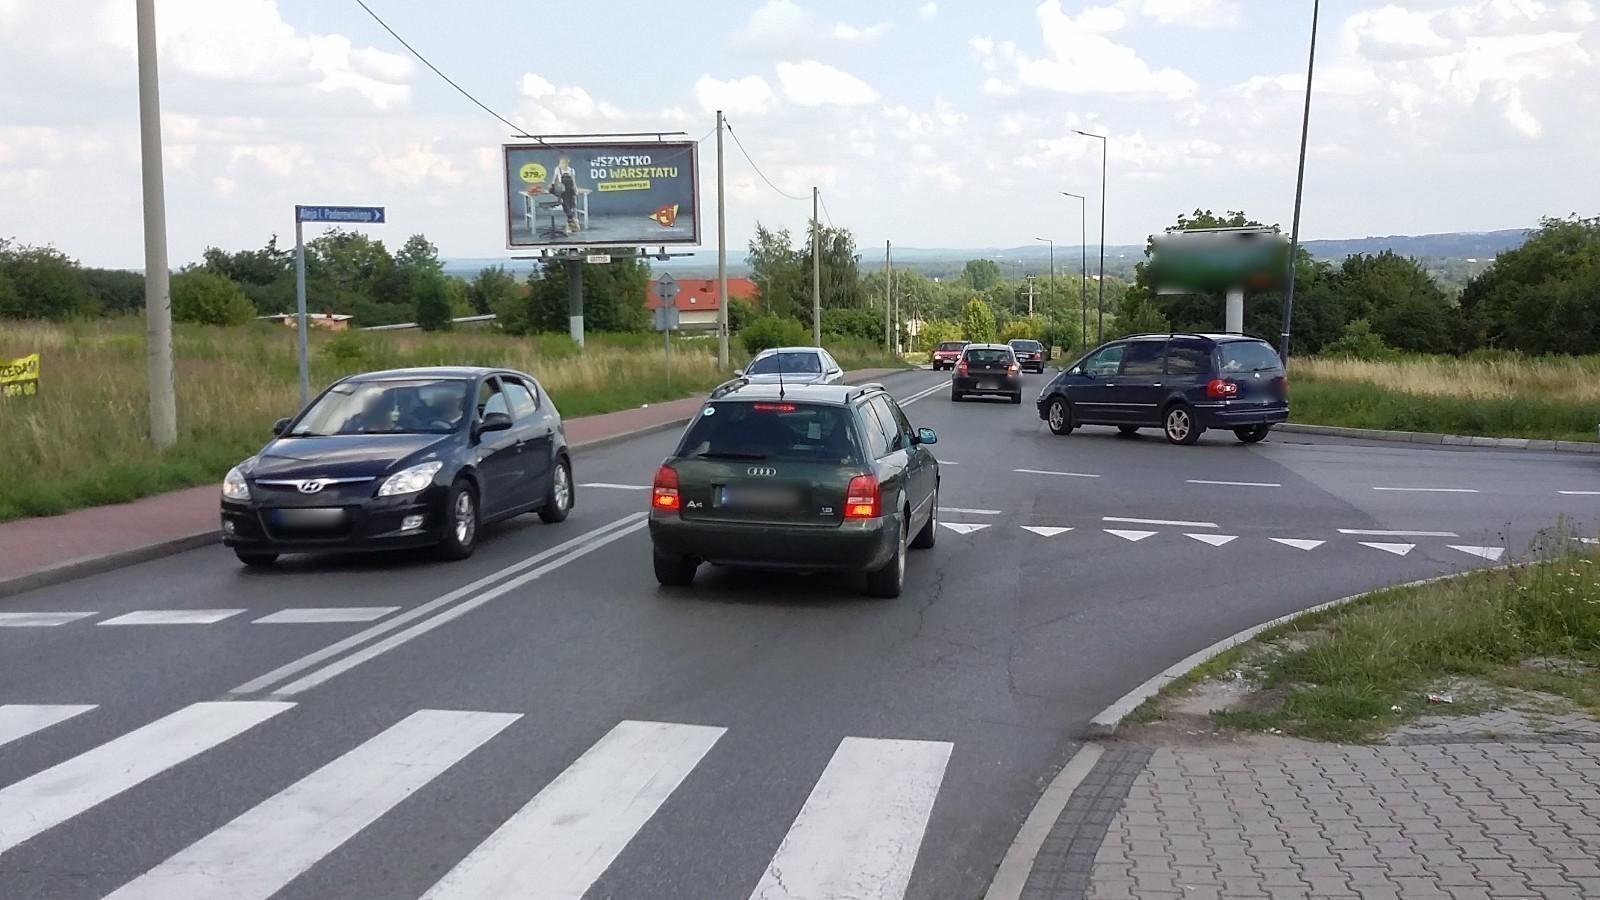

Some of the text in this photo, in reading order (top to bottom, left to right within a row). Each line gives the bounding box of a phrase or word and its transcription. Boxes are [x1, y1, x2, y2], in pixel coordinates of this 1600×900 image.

[590, 155, 652, 167] WSZYSTKO
[590, 167, 679, 179] DO WARSZTATU
[686, 500, 703, 508] A4
